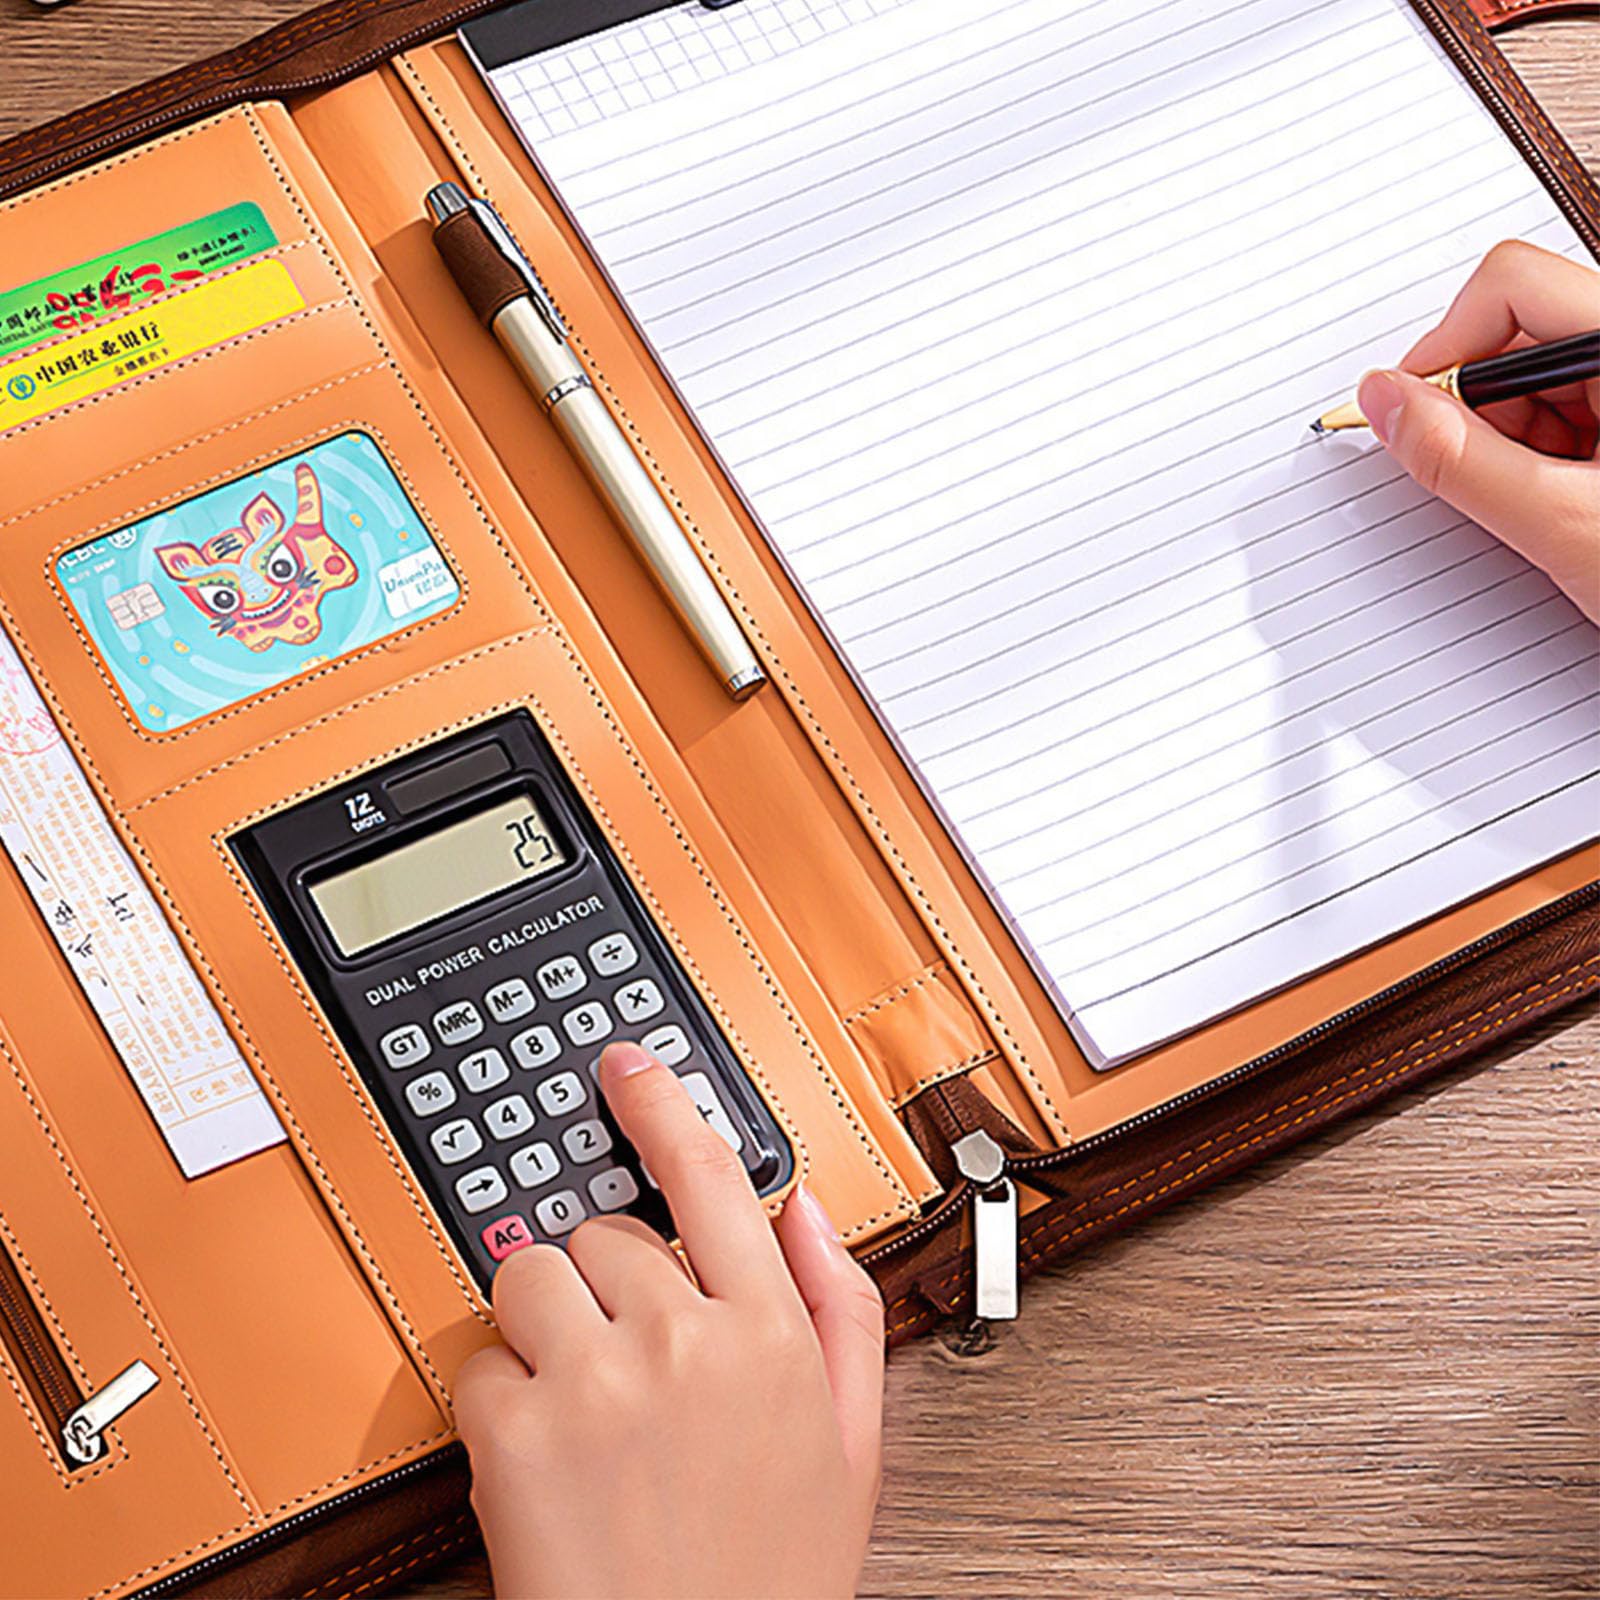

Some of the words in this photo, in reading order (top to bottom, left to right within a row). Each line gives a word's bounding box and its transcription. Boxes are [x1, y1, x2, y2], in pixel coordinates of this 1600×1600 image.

[36, 321, 160, 382] 中国农业银行
[344, 792, 376, 819] 12
[506, 815, 554, 869] 25
[365, 977, 417, 1007] DUAL
[417, 946, 486, 986] POWER
[487, 896, 605, 955] CALCULATOR
[542, 964, 577, 990] M+
[437, 1005, 478, 1036] MRC
[577, 1011, 595, 1034] 9
[389, 1032, 420, 1057] GT
[527, 1035, 544, 1056] 8
[471, 1057, 490, 1080] 7
[417, 1081, 443, 1101] %
[550, 1080, 570, 1103] 5
[501, 1104, 518, 1125] 4
[576, 1128, 597, 1150] 2
[526, 1151, 544, 1173] 1
[551, 1199, 569, 1221] 0
[493, 1222, 524, 1249] AC
